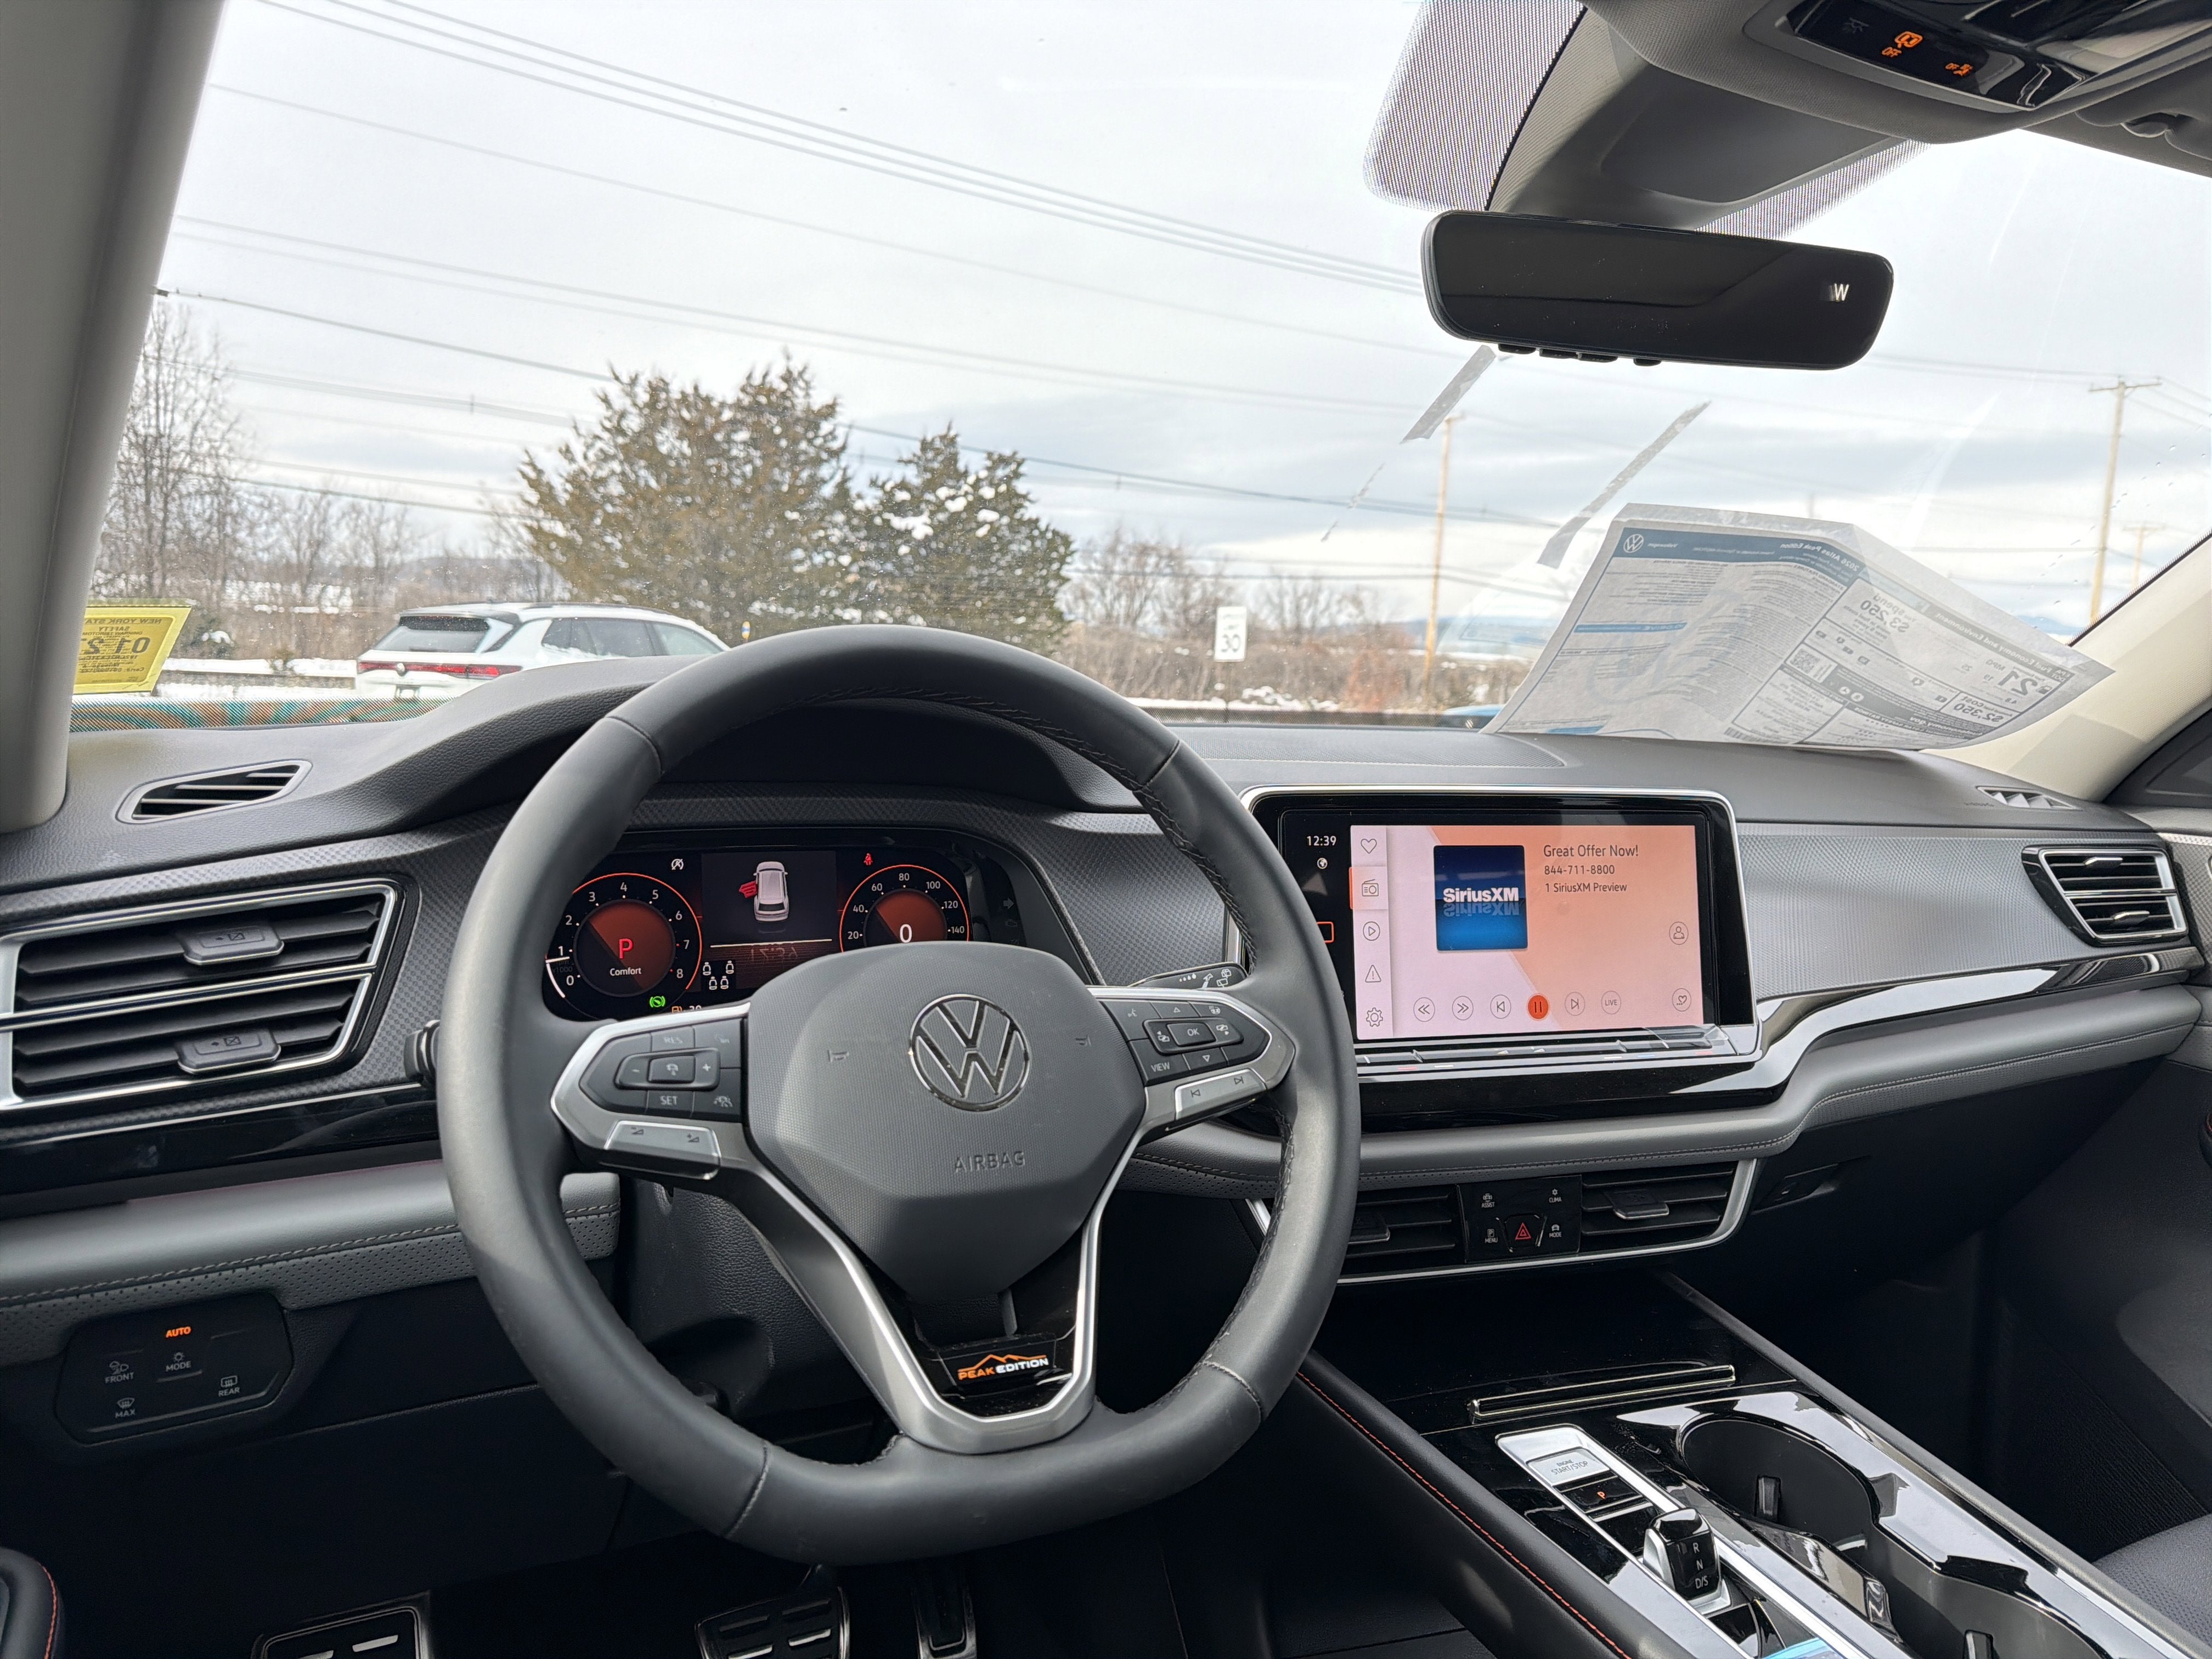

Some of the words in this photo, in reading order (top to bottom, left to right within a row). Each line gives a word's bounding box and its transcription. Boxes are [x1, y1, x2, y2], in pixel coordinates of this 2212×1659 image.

[1882, 47, 1902, 58] OFF
[1307, 836, 1336, 846] 12:39
[1543, 844, 1574, 857] Great
[1577, 844, 1606, 857] Offer
[1610, 844, 1639, 856] Now!
[1544, 865, 1615, 874] 844-711-8800
[899, 873, 910, 881] 80
[620, 882, 627, 891] 4
[871, 883, 883, 891] 60
[926, 881, 940, 889] 100
[1545, 883, 1550, 893] 1
[1554, 883, 1591, 893] SiriusXM
[1593, 882, 1627, 892] Preview
[589, 891, 596, 902] 3
[652, 890, 659, 900] 5
[1443, 887, 1519, 903] SiriusXM
[853, 905, 864, 913] 40
[945, 900, 958, 909] 120
[675, 910, 682, 920] 6
[566, 915, 572, 926] 2
[900, 924, 912, 943] 0
[951, 926, 964, 934] 140
[848, 931, 859, 940] 20
[619, 938, 633, 959] P
[684, 940, 690, 950] 7
[558, 946, 564, 956] 1
[610, 967, 642, 977] Comfort
[676, 969, 684, 978] 8
[566, 975, 574, 985] 0
[1187, 1028, 1200, 1036] OK
[1151, 1062, 1171, 1073] VIEW
[659, 1096, 678, 1106] SET
[954, 1151, 1025, 1173] AIRBAG
[166, 1326, 191, 1338] AUTO
[166, 1361, 191, 1372] MODE
[958, 1367, 996, 1380] PEAK
[995, 1358, 1049, 1373] EDITION
[105, 1372, 134, 1384] FRONT
[218, 1386, 240, 1397] REAR
[115, 1409, 136, 1419] MAX
[1551, 1461, 1588, 1475] START/STOP
[1597, 1491, 1605, 1499] P
[1693, 1542, 1700, 1554] R
[1696, 1559, 1703, 1571] N
[1695, 1576, 1708, 1589] D/S
